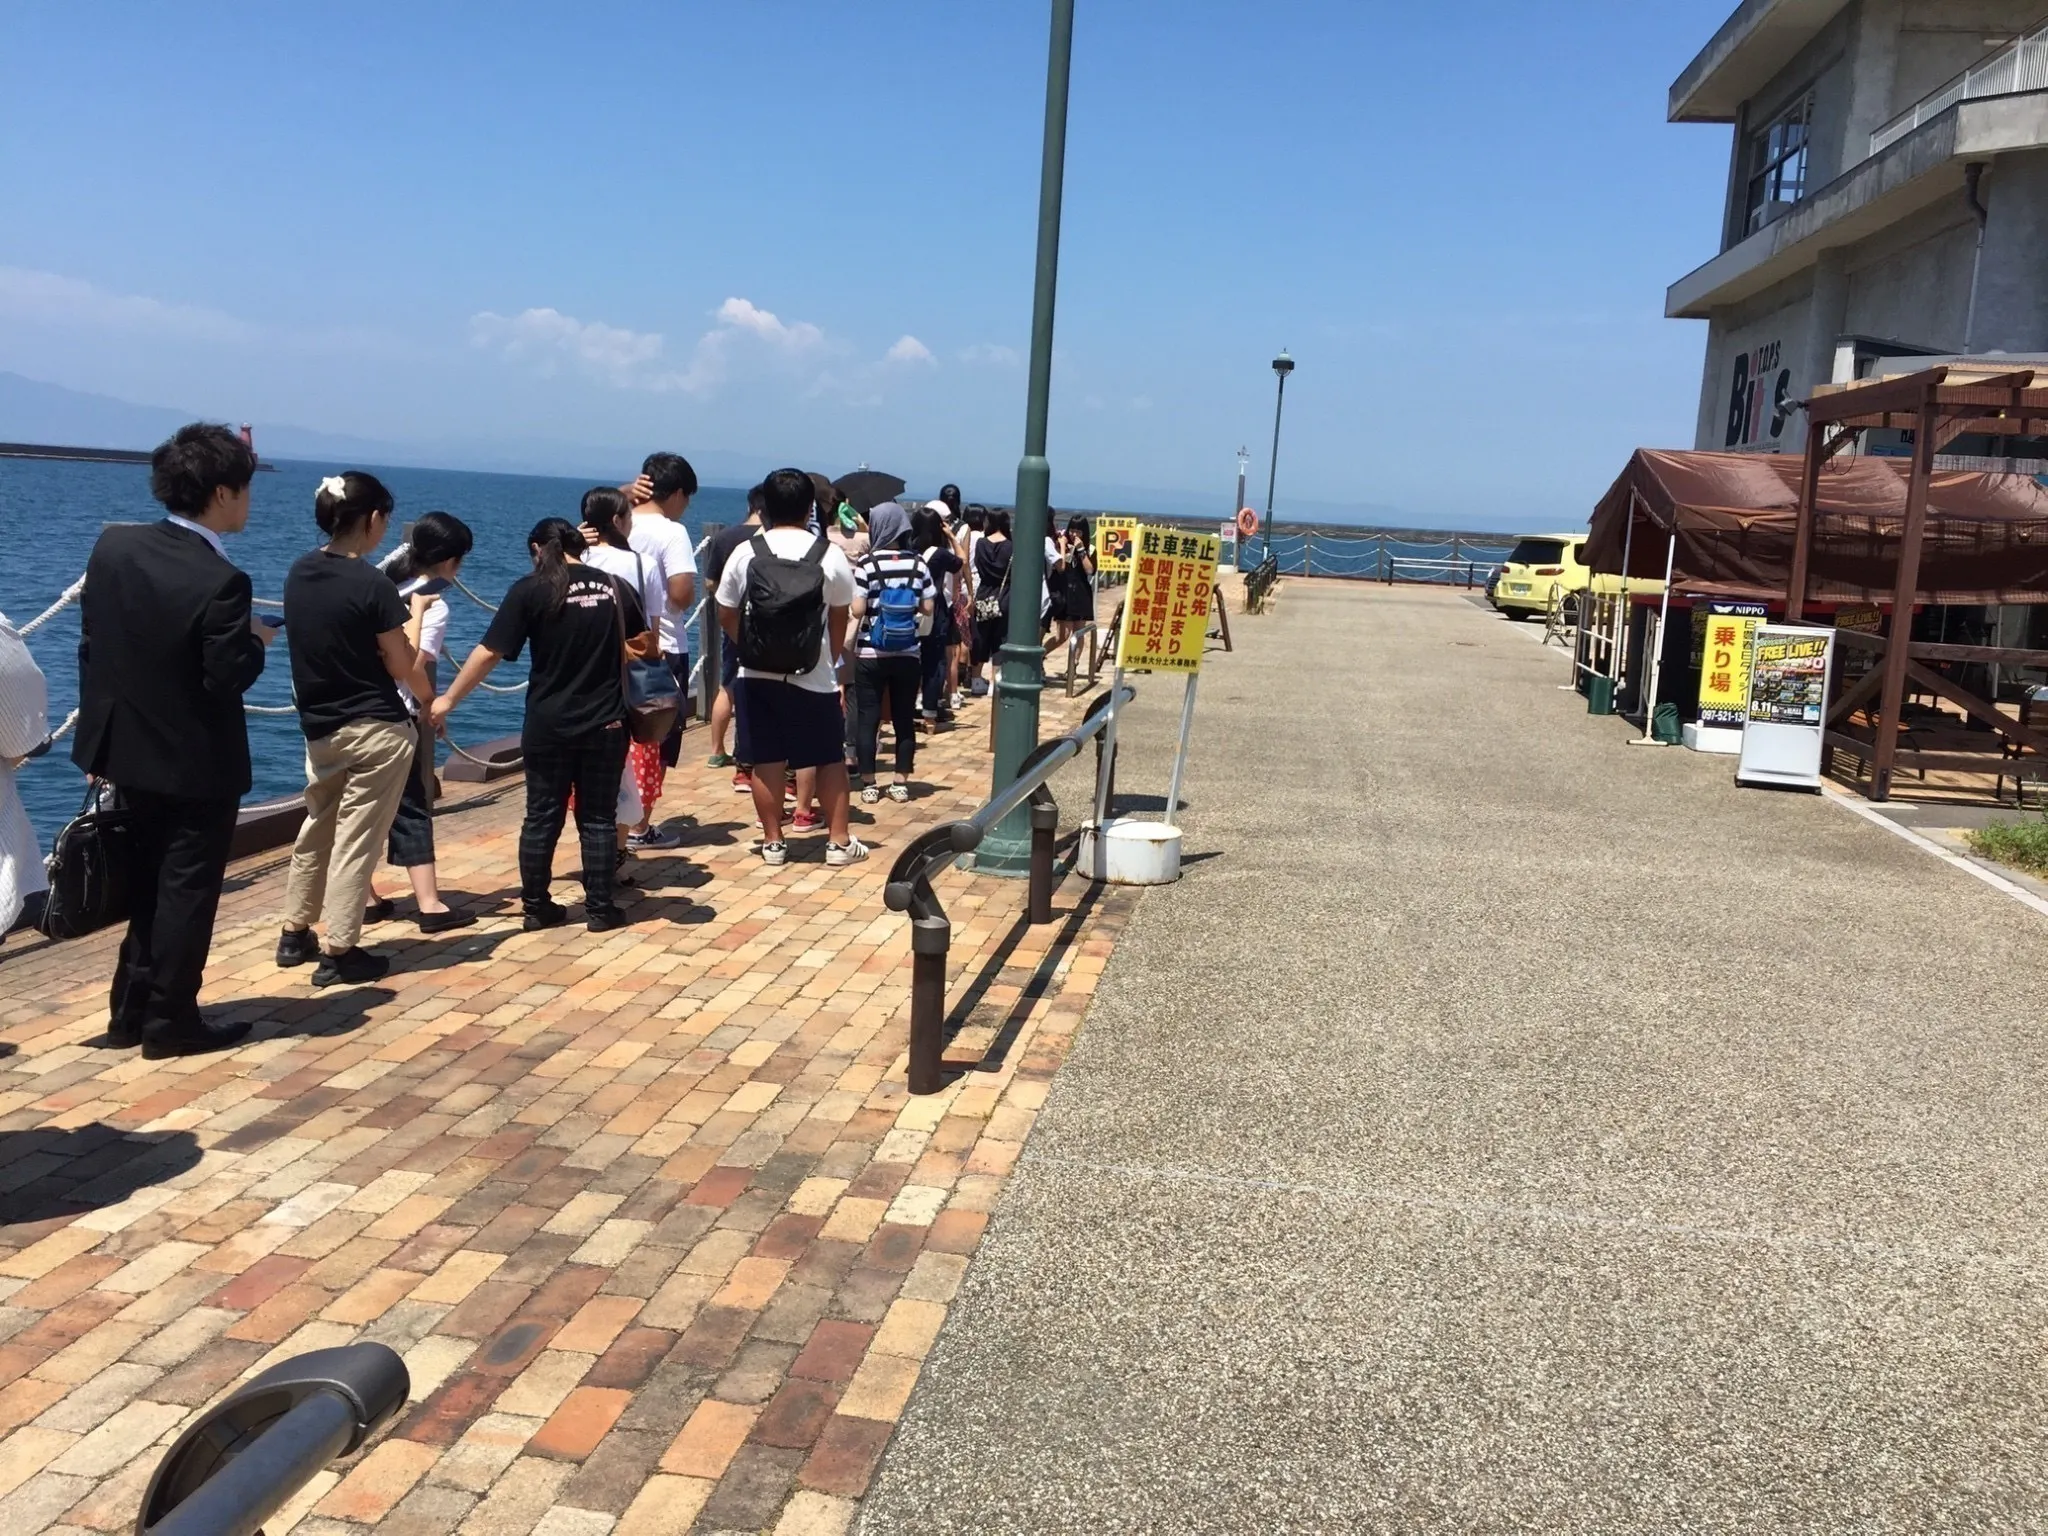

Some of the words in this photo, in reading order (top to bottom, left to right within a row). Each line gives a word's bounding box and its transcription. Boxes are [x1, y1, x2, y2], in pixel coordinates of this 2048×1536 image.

[1099, 519, 1135, 528] 駐車禁止
[1143, 532, 1215, 561] 駐車禁止
[1129, 557, 1154, 636] 進入禁止
[1191, 564, 1211, 616] この先
[1168, 562, 1194, 654] 行き止まり
[1735, 606, 1765, 615] NIPPO
[1709, 627, 1736, 692] 乗り場
[1758, 645, 1786, 660] FREE
[1788, 640, 1826, 658] LIVE!!
[1752, 700, 1771, 712] 8.11
